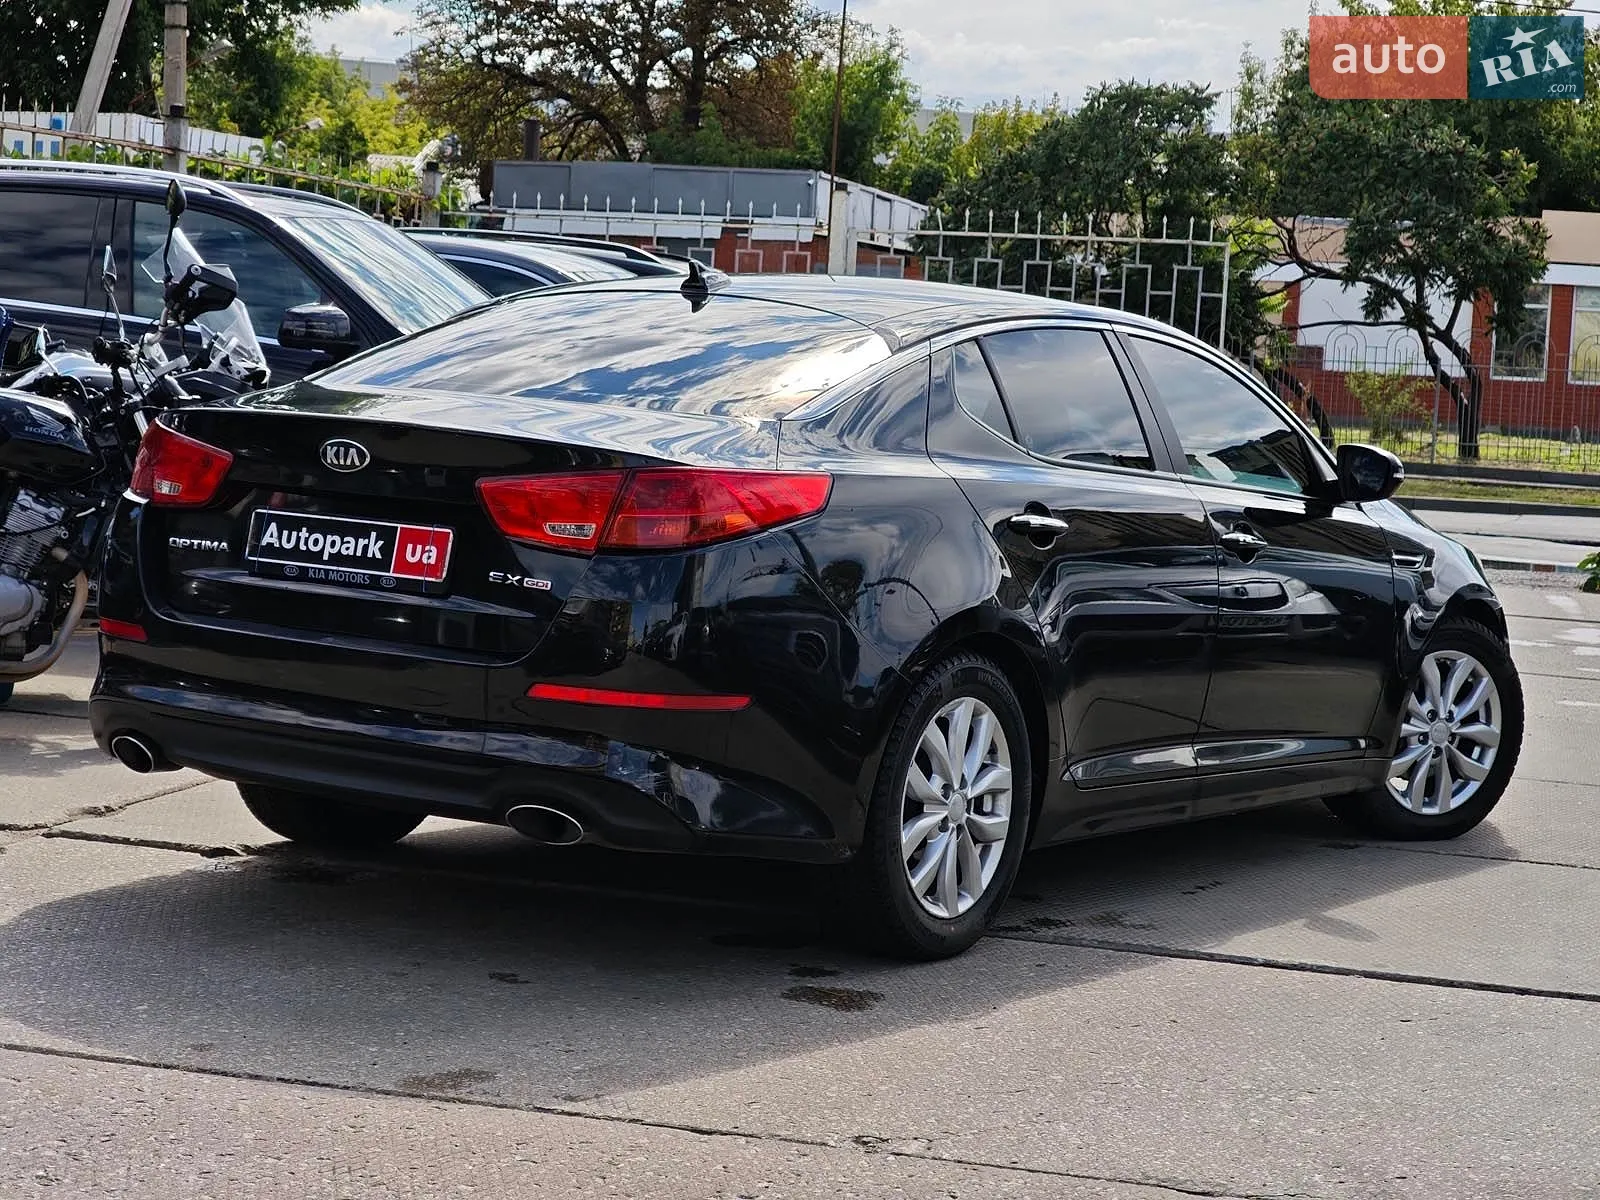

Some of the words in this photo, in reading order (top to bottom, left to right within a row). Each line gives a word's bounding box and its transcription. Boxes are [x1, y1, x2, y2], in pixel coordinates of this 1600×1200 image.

[24, 426, 65, 440] HONDA
[325, 445, 361, 467] KIA
[168, 537, 230, 552] OPTIMA
[261, 521, 385, 561] Autopark
[404, 543, 438, 565] ua
[308, 567, 326, 579] KIA
[328, 570, 371, 585] MOTORS
[488, 571, 522, 586] EX
